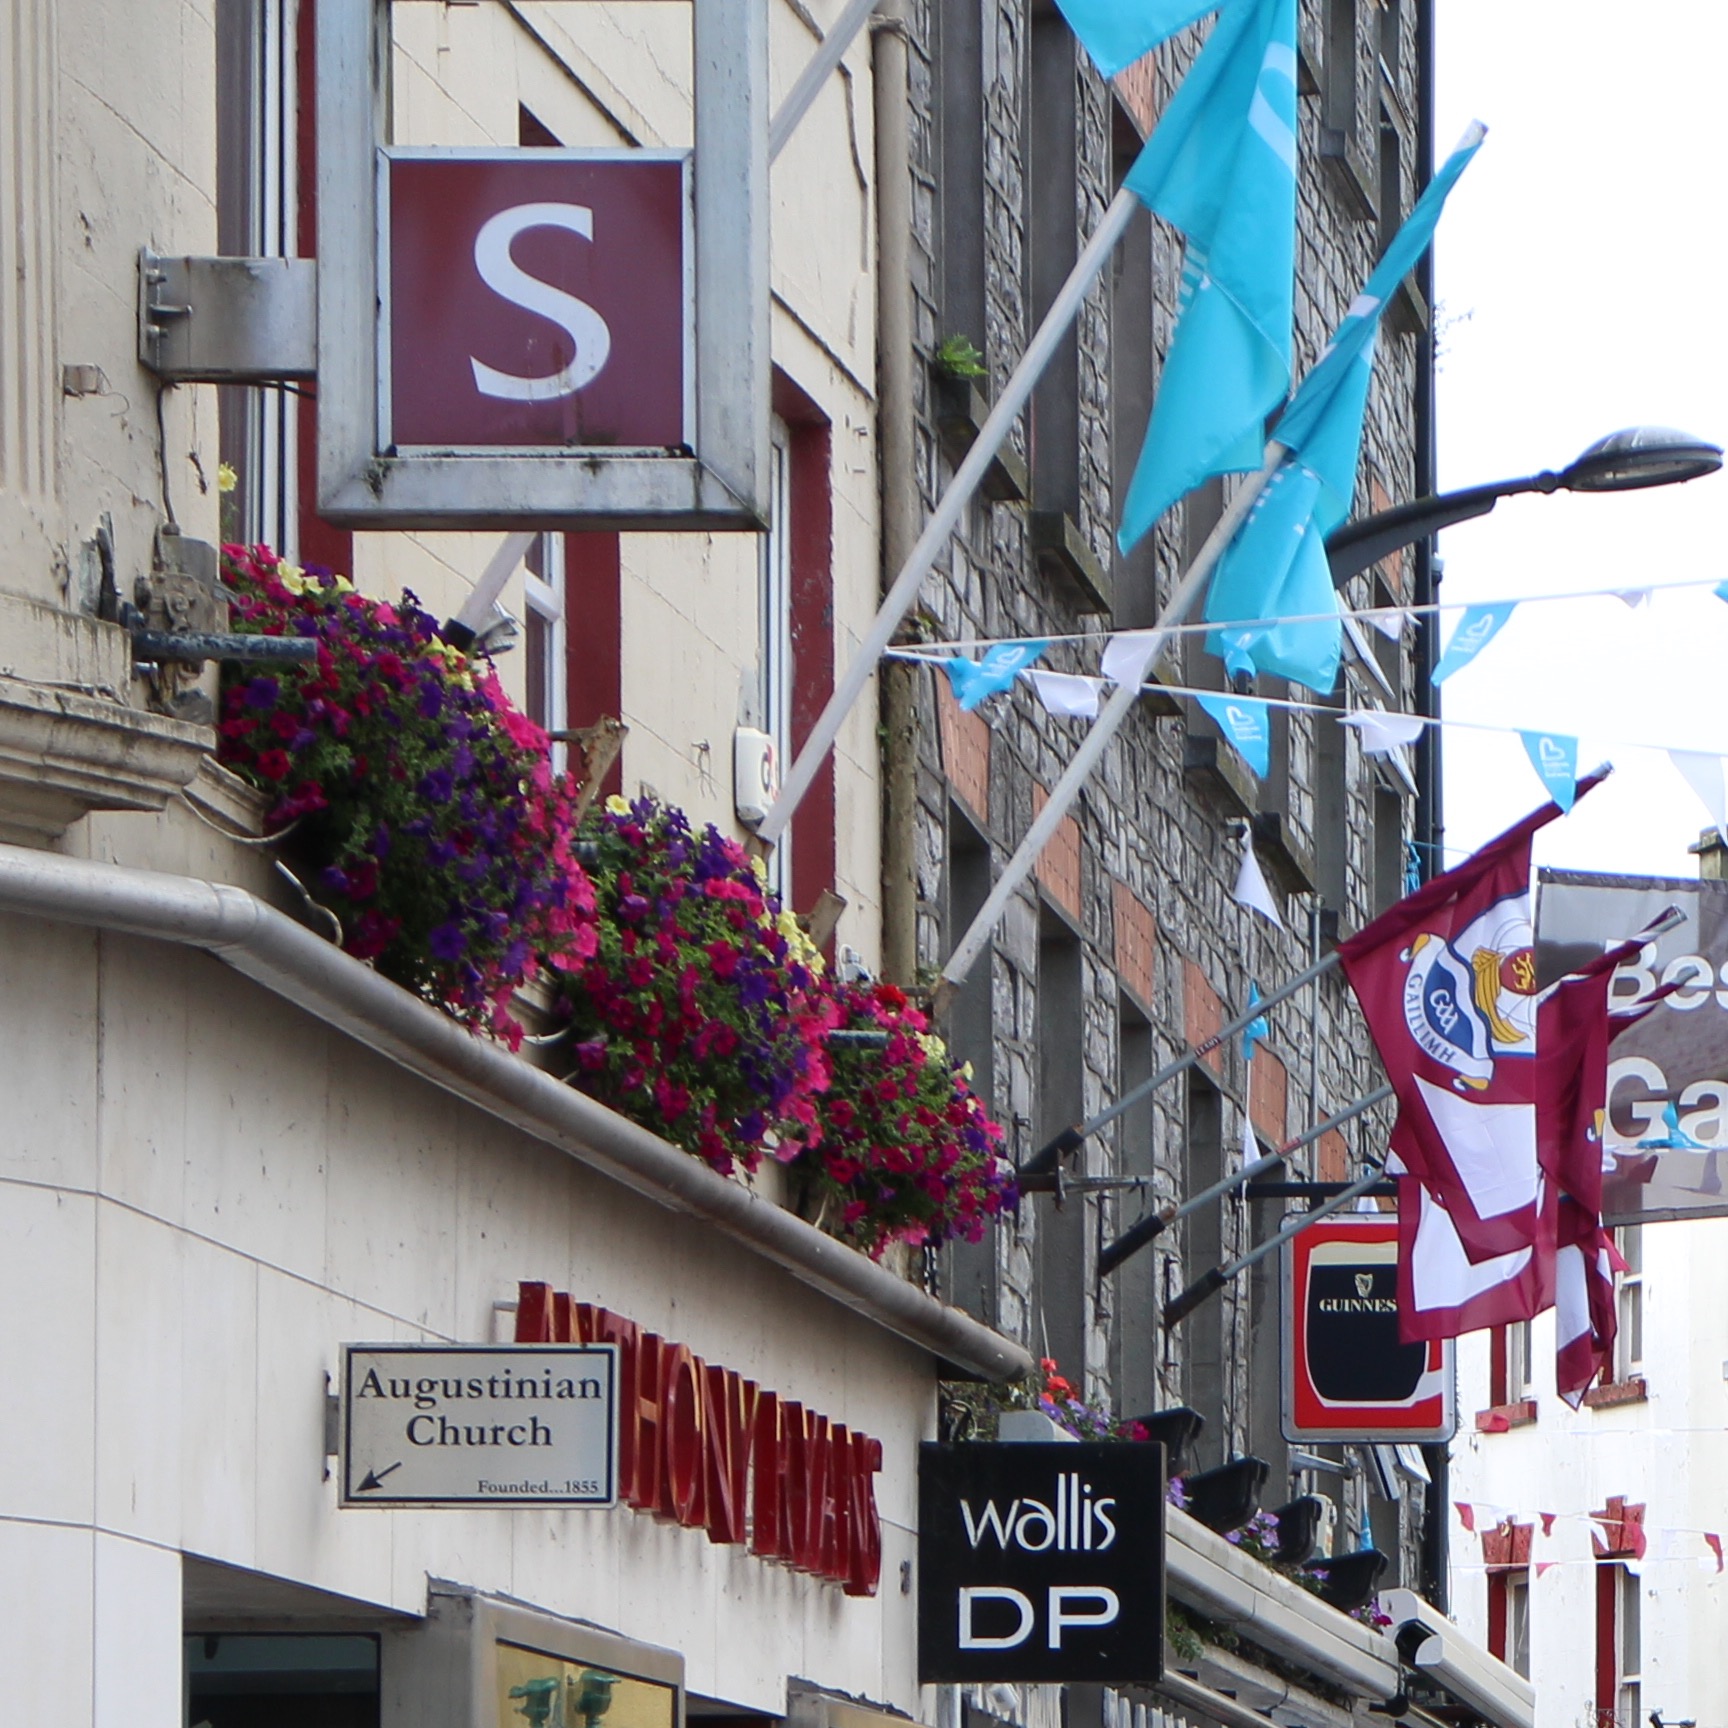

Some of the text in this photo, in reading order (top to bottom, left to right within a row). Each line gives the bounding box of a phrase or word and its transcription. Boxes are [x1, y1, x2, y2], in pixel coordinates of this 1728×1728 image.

[469, 202, 612, 401] S
[1406, 973, 1456, 1063] GAILLIMH
[358, 1367, 602, 1414] Augustinian
[405, 1414, 553, 1447] Church
[957, 1585, 1121, 1650] DP
